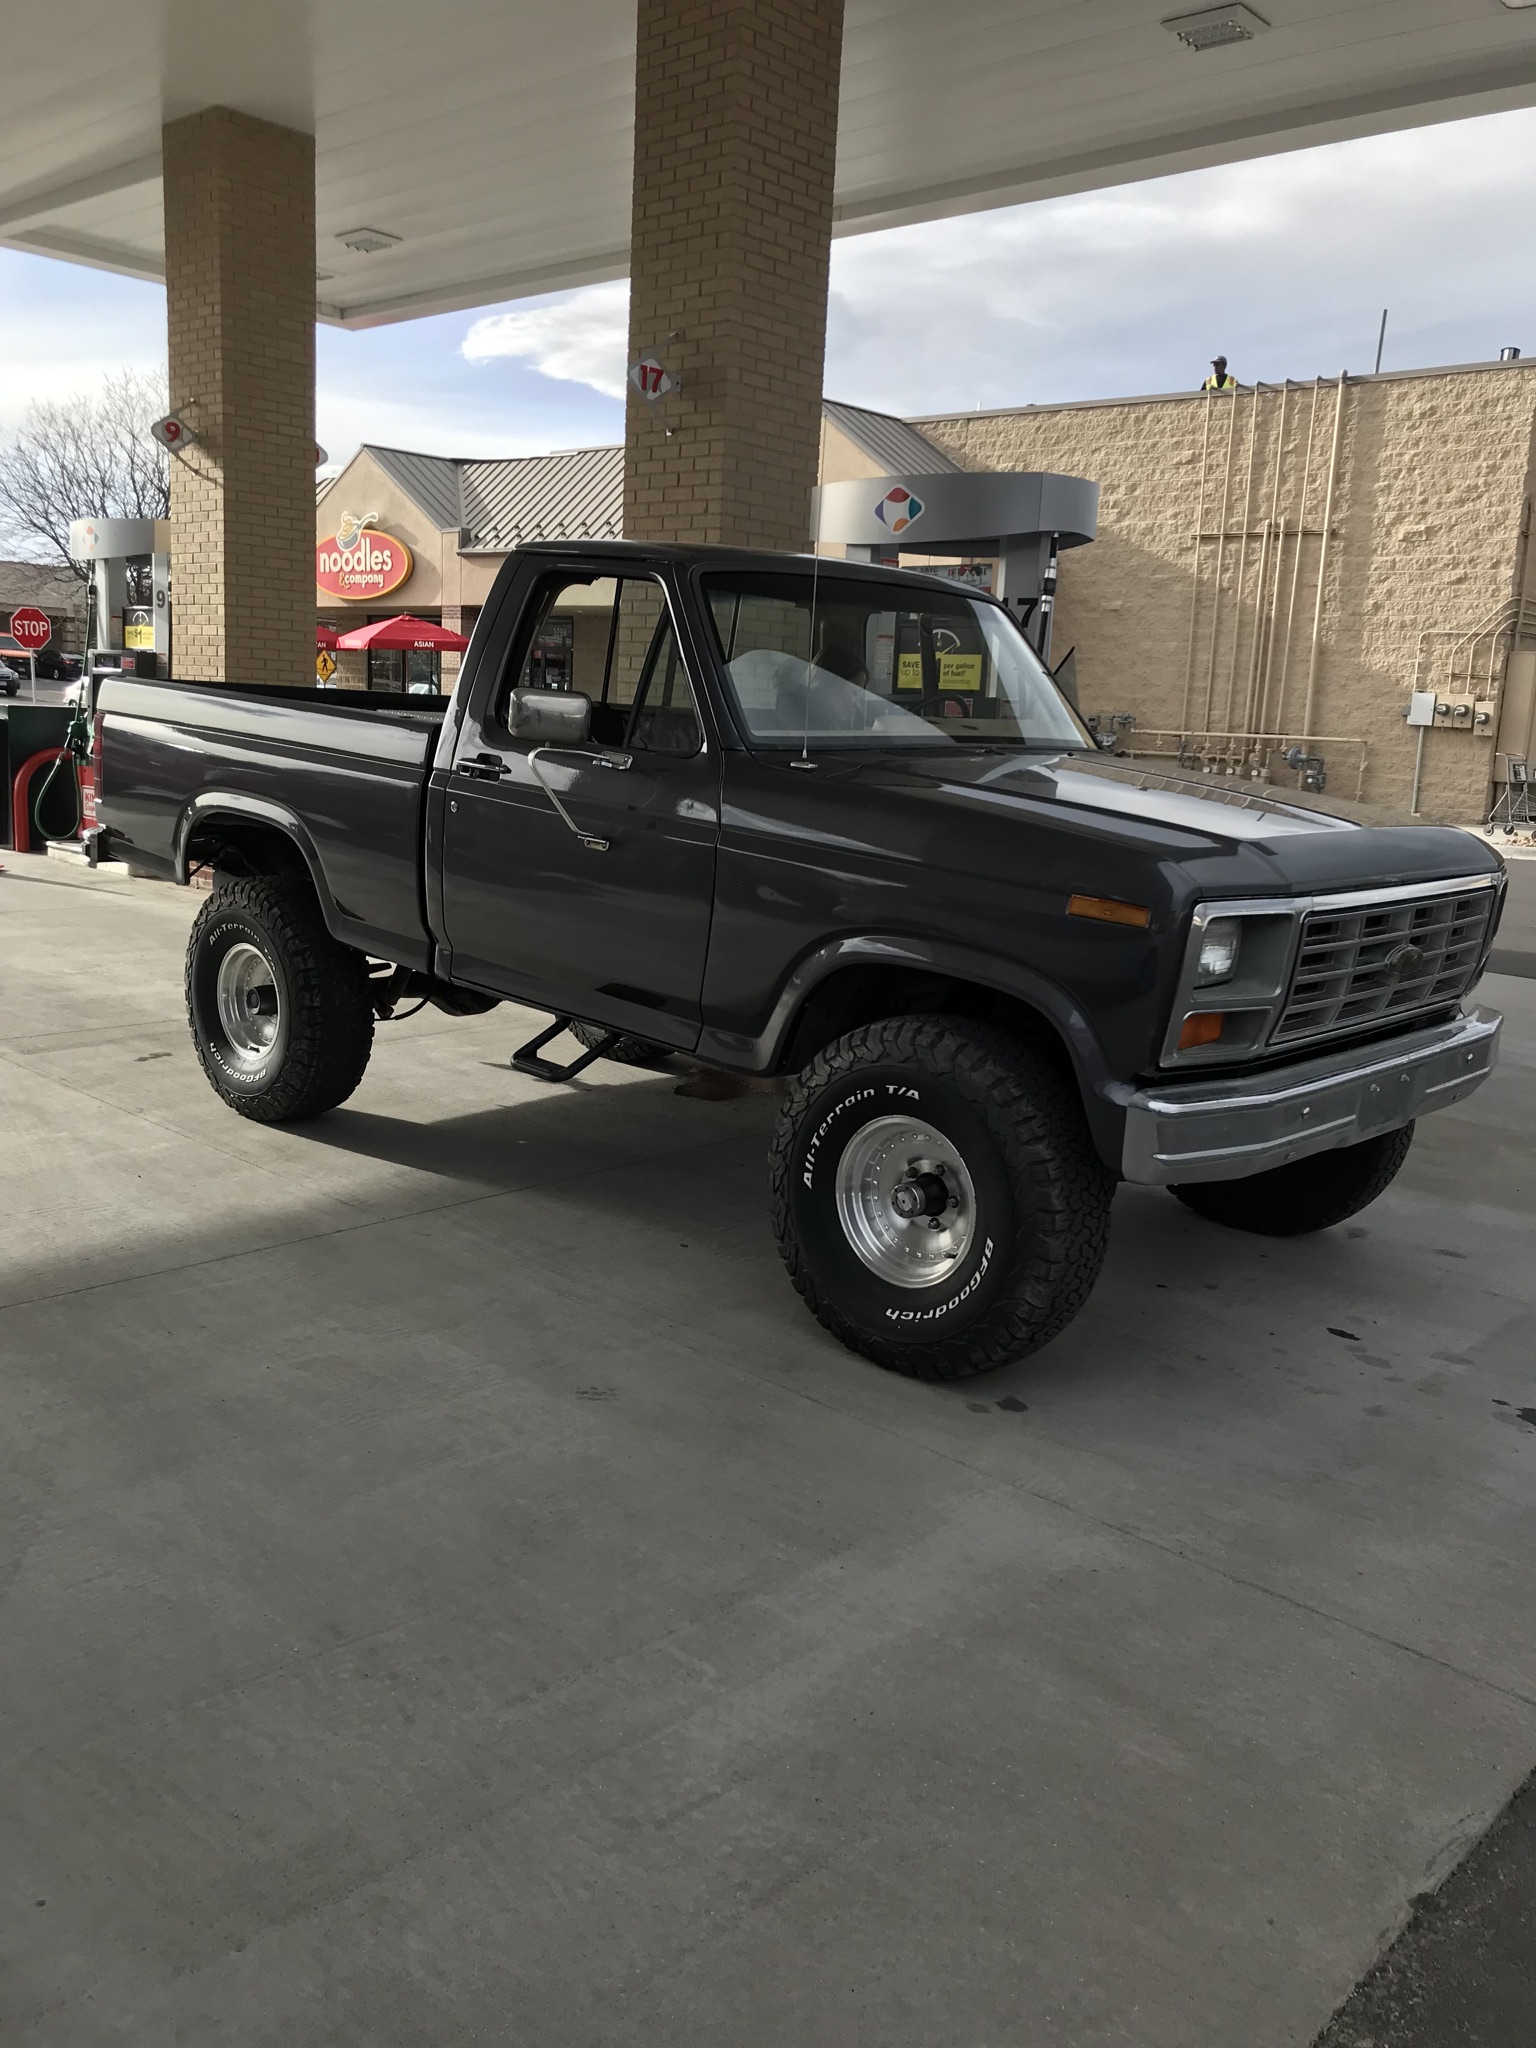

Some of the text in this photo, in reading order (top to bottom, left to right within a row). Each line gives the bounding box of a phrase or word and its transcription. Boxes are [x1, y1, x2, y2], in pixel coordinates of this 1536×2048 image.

[640, 364, 664, 393] 17
[165, 421, 181, 443] 9
[319, 536, 394, 573] noodles
[156, 589, 166, 609] 9
[1002, 597, 1039, 628] 7
[14, 619, 49, 637] STOP
[413, 640, 435, 648] ASIAN
[901, 668, 920, 677] up to
[902, 661, 920, 669] SAVE
[943, 663, 954, 671] per
[209, 922, 261, 946] All-Terrain
[209, 1042, 268, 1083] BFGoodrich
[802, 1084, 920, 1191] All-Terrain T/A
[884, 1236, 995, 1323] BFGoodrich
